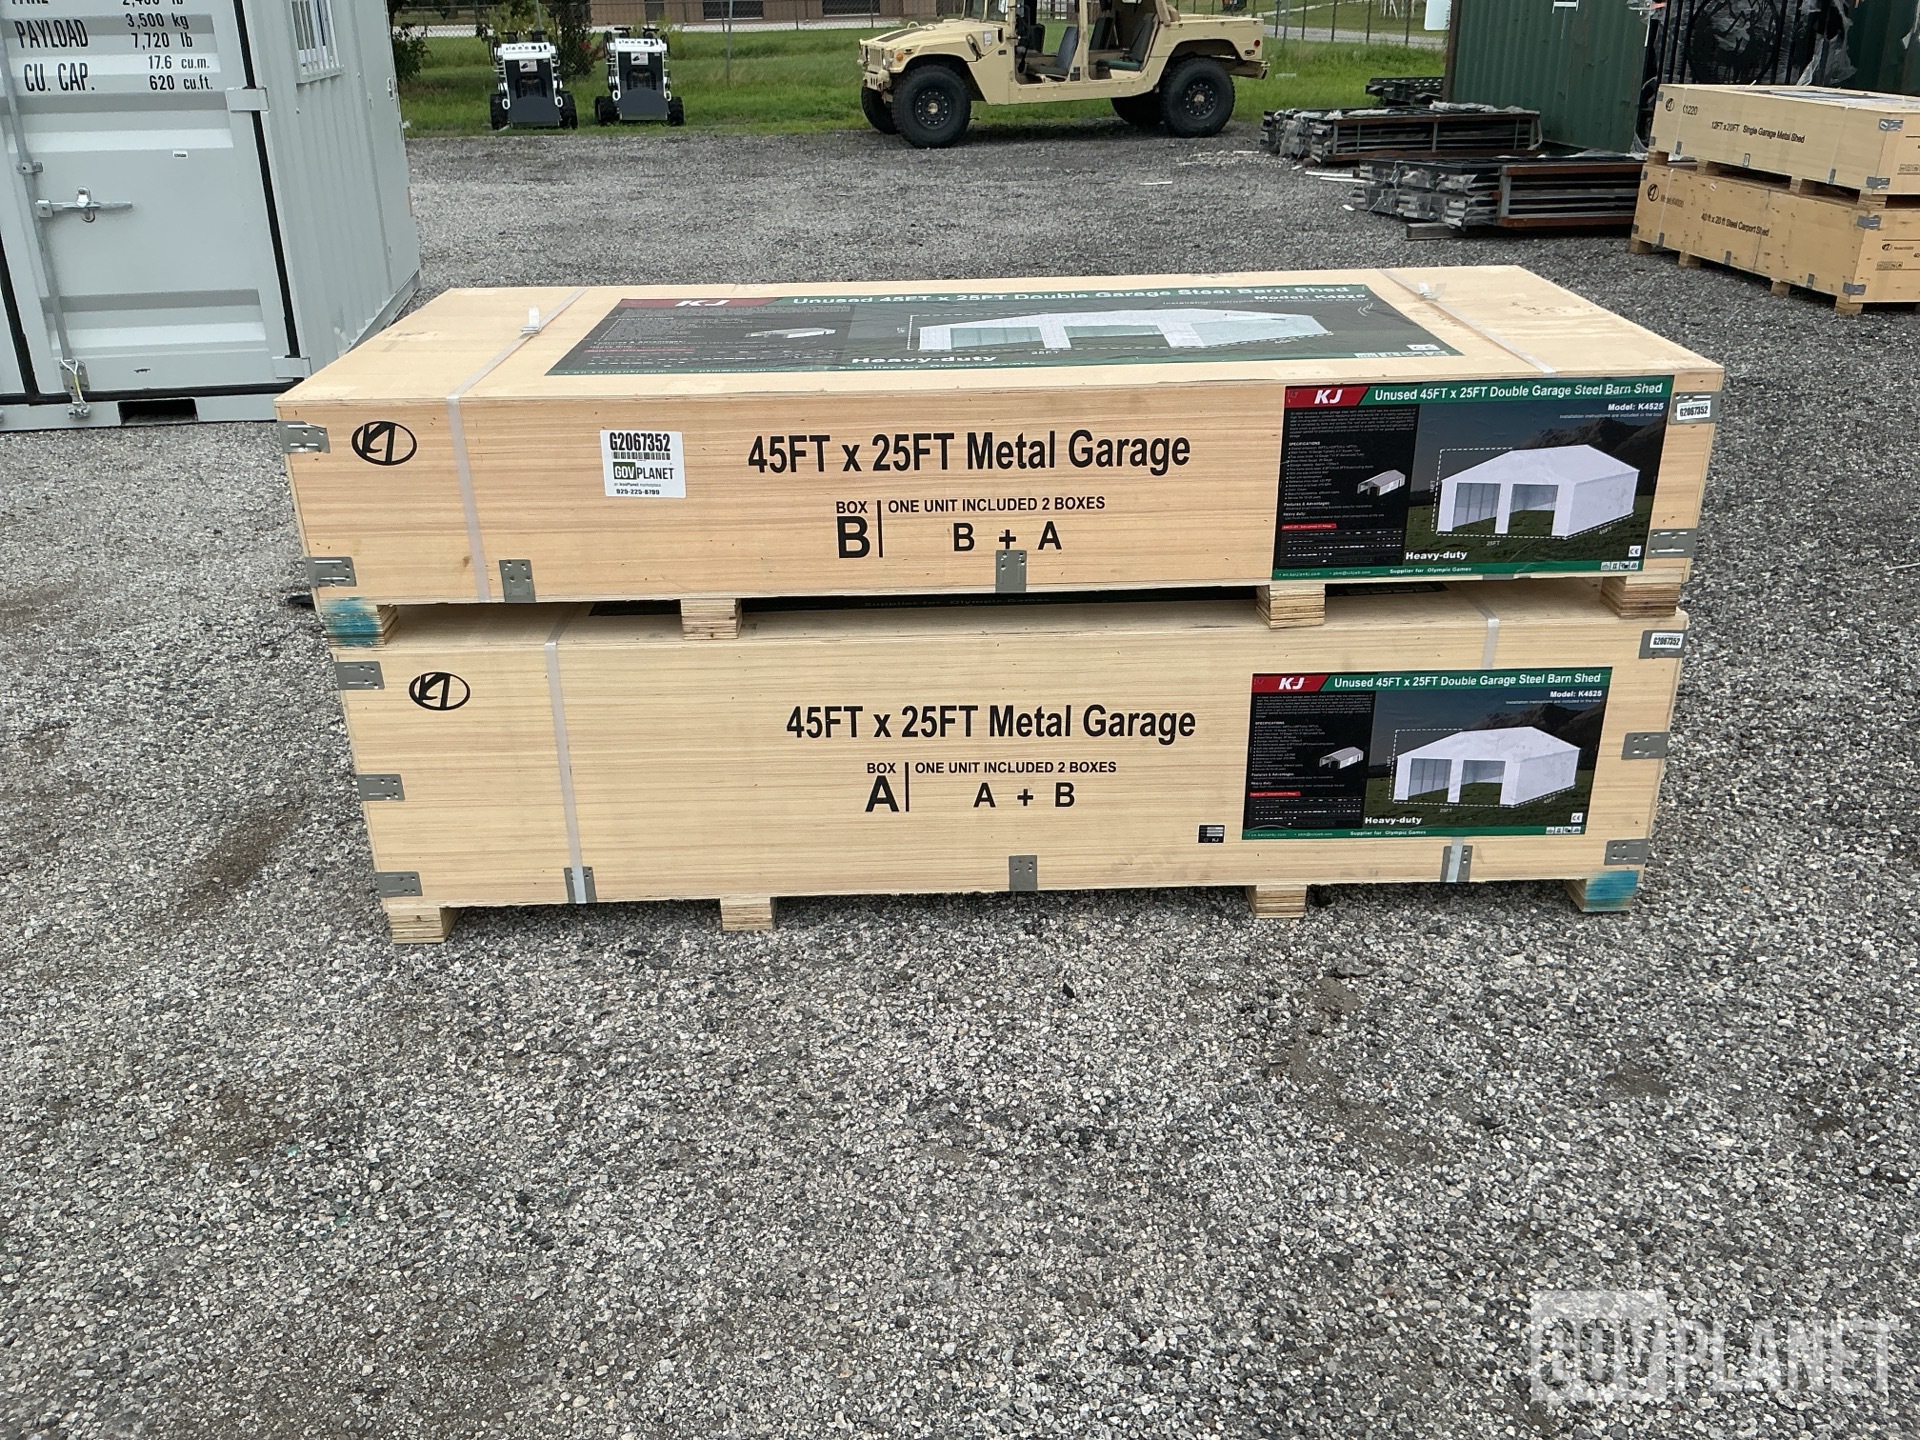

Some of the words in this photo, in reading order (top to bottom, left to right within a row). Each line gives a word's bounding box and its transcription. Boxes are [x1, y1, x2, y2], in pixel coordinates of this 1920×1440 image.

[125, 13, 165, 29] 3,500
[171, 12, 189, 29] kg
[15, 19, 89, 49] PAYLOAD
[131, 32, 170, 50] 7,720
[180, 32, 193, 48] lb
[148, 55, 172, 70] 17.6
[181, 56, 210, 69] cu.m.
[24, 63, 51, 92] CU.
[57, 62, 95, 92] CAP.
[149, 75, 175, 90] 620
[183, 74, 213, 90] cu.ft.
[1742, 124, 1758, 136] Single
[1758, 127, 1777, 139] Garage
[1777, 130, 1791, 141] Metal
[1790, 132, 1806, 144] Shed
[1715, 215, 1722, 225] 20
[1726, 218, 1739, 229] Steel
[1738, 221, 1757, 233] Carport
[1756, 225, 1771, 237] Shed
[675, 299, 731, 307] KJ
[793, 296, 873, 305] Unused
[880, 295, 931, 303] 45FT
[956, 294, 1008, 302] 25FT
[1014, 291, 1089, 301] Double
[1095, 290, 1171, 299] Garage
[1177, 288, 1231, 297] Steel
[1237, 287, 1289, 295] Barn
[1294, 286, 1350, 294] Shed
[851, 355, 997, 364] Heavy-duty
[1313, 388, 1344, 405] KJ
[1374, 389, 1418, 402] Unused
[1419, 387, 1449, 401] 45FT
[1449, 390, 1457, 399] x
[1459, 385, 1488, 399] 25FT
[1489, 384, 1530, 398] Double
[1531, 383, 1572, 399] Garage
[1574, 382, 1604, 396] Steel
[1604, 381, 1632, 395] Barn
[1633, 380, 1663, 395] Shed
[1607, 402, 1636, 412] Model:
[1637, 402, 1665, 411] K4525
[609, 432, 671, 452] G2067352
[748, 434, 831, 474] 45FT
[841, 443, 863, 472] x
[871, 432, 955, 472] 25FT
[966, 430, 1055, 470] Metal
[1068, 428, 1190, 476] Garage
[614, 465, 675, 480] GOVPLANET
[836, 500, 868, 514] BOX
[888, 499, 920, 514] ONE
[924, 498, 958, 513] UNIT
[962, 496, 1038, 513] INCLUDED
[1041, 496, 1051, 511] 2
[1053, 495, 1106, 511] BOXES
[836, 515, 871, 559] B
[952, 522, 976, 552] B
[998, 529, 1017, 550] +
[1037, 520, 1063, 551] A
[1486, 539, 1501, 547] 25FT
[1405, 549, 1468, 562] Heavy-duty
[1389, 567, 1417, 576] Supplier
[1417, 566, 1425, 574] for
[1427, 565, 1450, 575] Olympic
[1451, 564, 1472, 573] Games
[1278, 677, 1305, 690] KJ
[1334, 677, 1374, 689] Unused
[1376, 676, 1402, 688] 45FT
[1403, 678, 1410, 687] x
[1412, 675, 1439, 687] 25FT
[1440, 674, 1477, 687] Double
[1479, 673, 1517, 688] Garage
[1518, 672, 1545, 685] Steel
[1547, 671, 1573, 685] Barn
[1573, 671, 1602, 684] Shed
[1549, 690, 1576, 699] Model:
[1577, 689, 1603, 698] K4525
[786, 705, 864, 739] 45FT
[873, 713, 892, 738] x
[901, 704, 978, 738] 25FT
[989, 704, 1072, 738] Metal
[1083, 703, 1197, 745] Garage
[866, 762, 897, 774] BOX
[914, 762, 945, 774] ONE
[948, 761, 981, 774] UNIT
[984, 761, 1055, 774] INCLUDED
[1057, 761, 1066, 773] 2
[1069, 760, 1118, 774] BOXES
[864, 774, 901, 813] A
[972, 782, 997, 808] A
[1017, 788, 1034, 807] +
[1054, 782, 1076, 808] B
[1364, 815, 1422, 826] Heavy-duty
[1349, 830, 1375, 838] Supplier
[1384, 829, 1406, 838] Olympic
